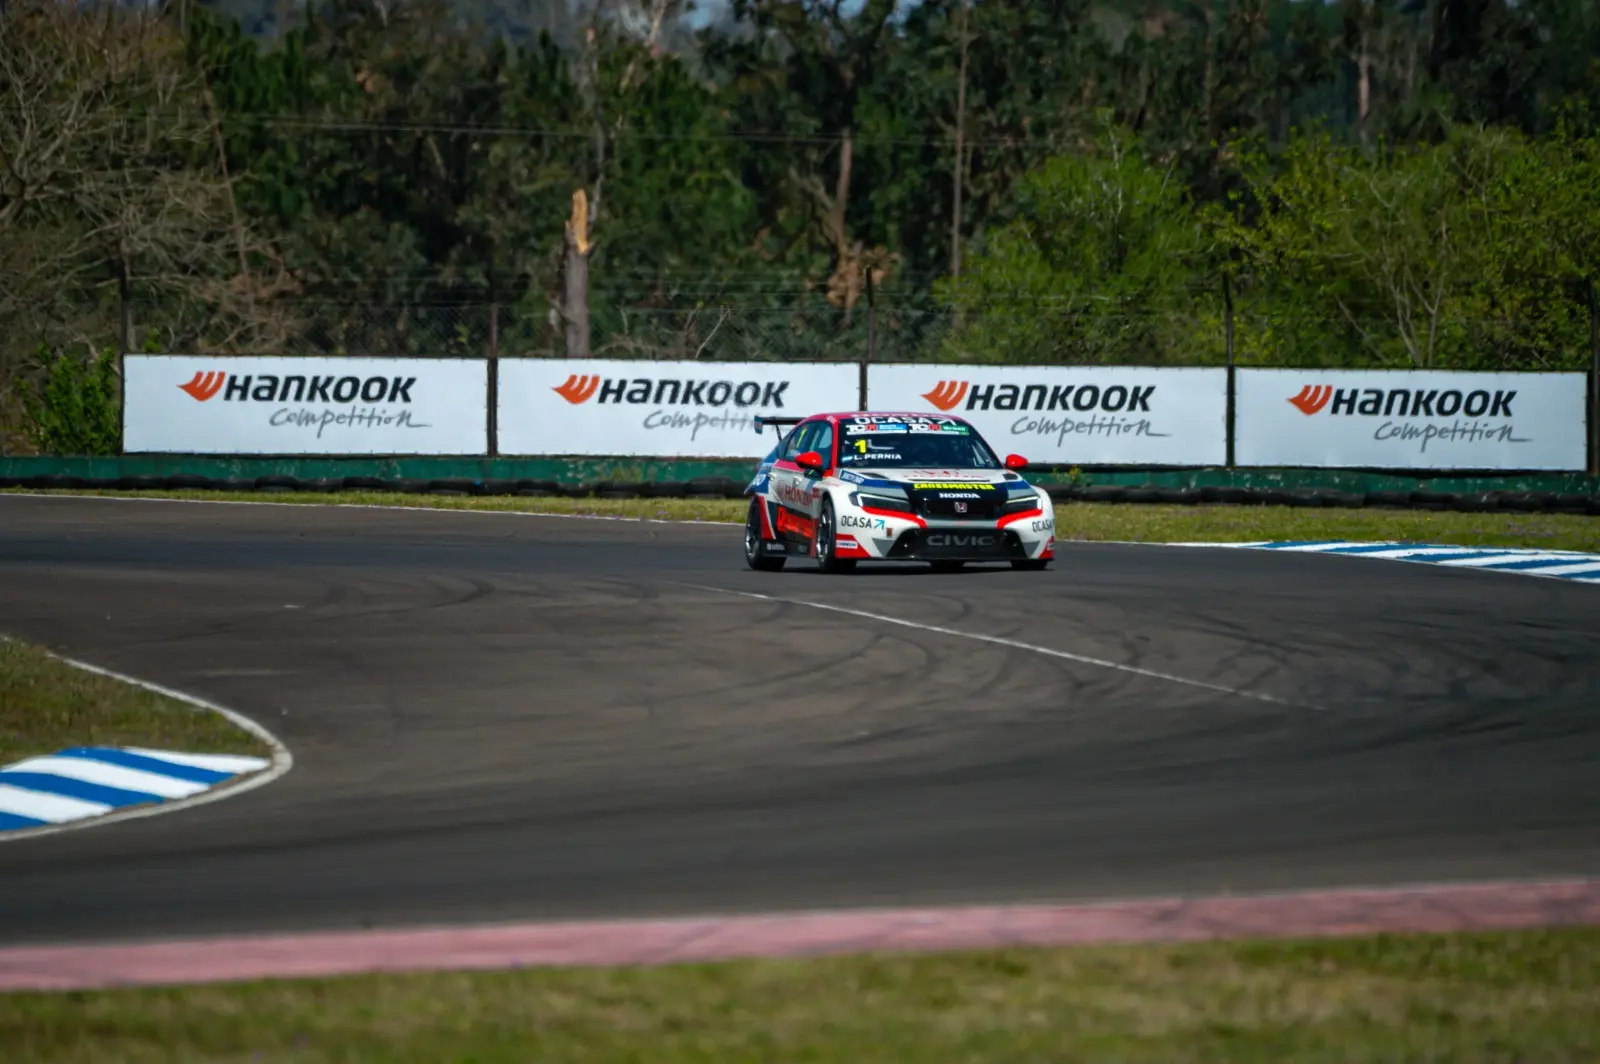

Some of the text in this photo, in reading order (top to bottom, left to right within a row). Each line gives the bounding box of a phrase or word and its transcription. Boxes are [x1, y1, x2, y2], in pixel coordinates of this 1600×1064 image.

[269, 405, 432, 439] Competition
[855, 416, 932, 425] OCASA
[1011, 414, 1172, 448] Competition
[1374, 420, 1533, 453] Competition
[854, 440, 867, 453] 1
[841, 515, 873, 529] OCASA
[926, 535, 995, 546] CIVIC
